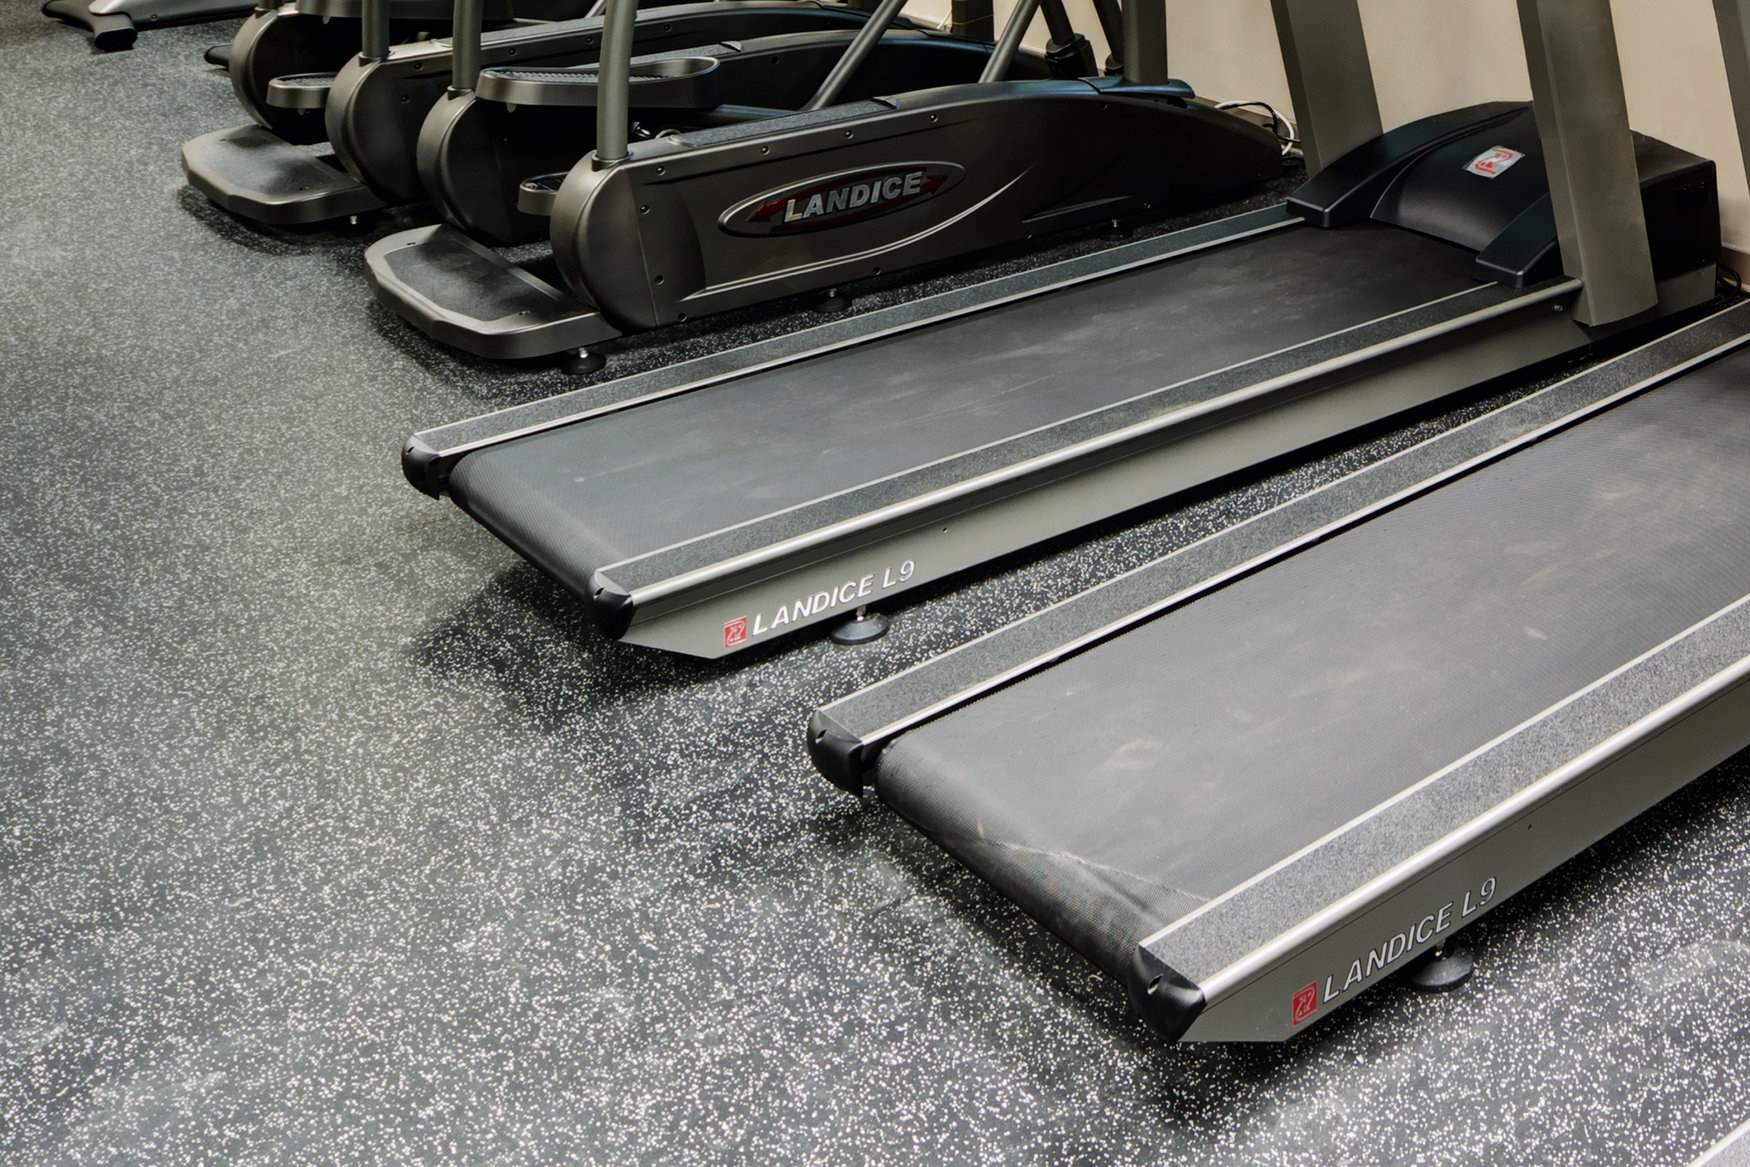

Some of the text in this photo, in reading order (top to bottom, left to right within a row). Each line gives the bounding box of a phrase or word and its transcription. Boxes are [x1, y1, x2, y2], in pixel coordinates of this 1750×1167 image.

[783, 171, 924, 223] LANDICE
[752, 560, 917, 636] LANDICE L9
[1323, 877, 1497, 1004] LANDICE L9
